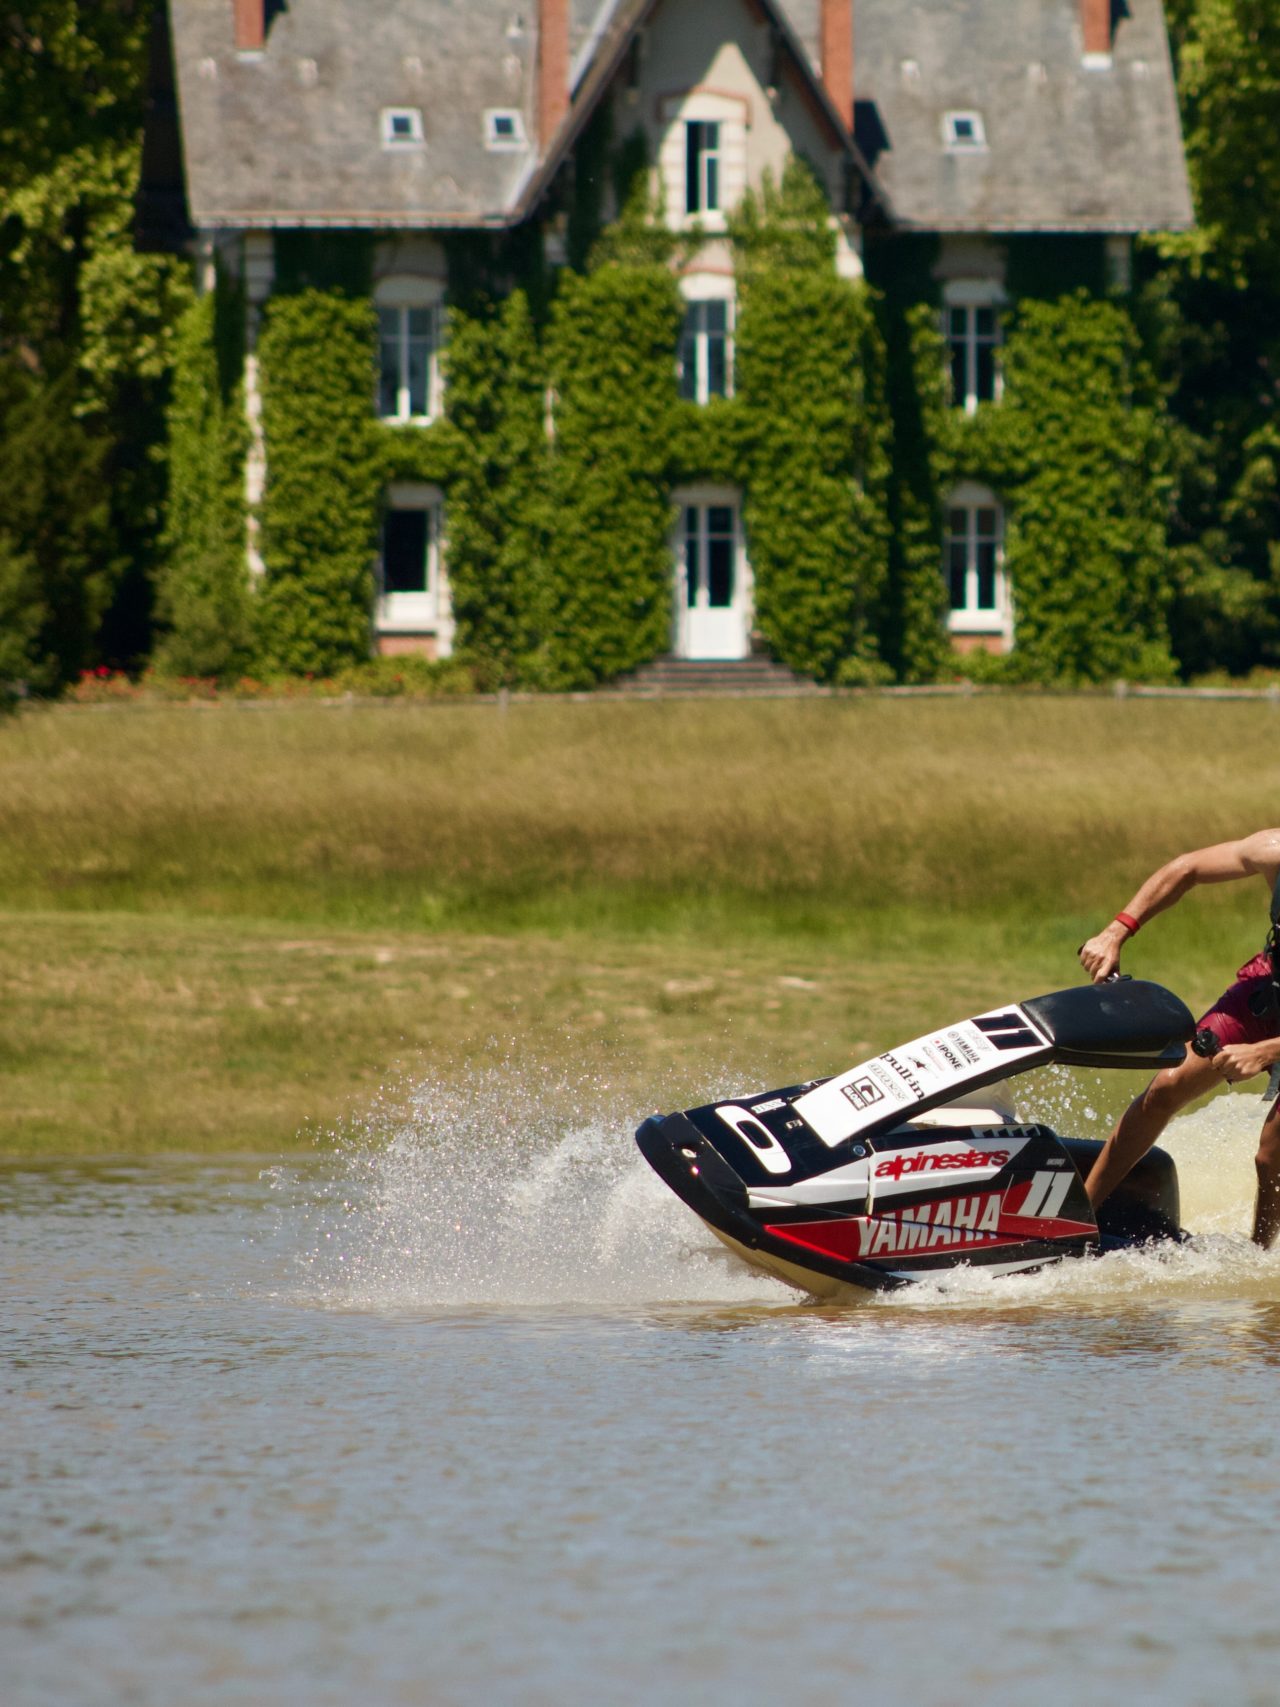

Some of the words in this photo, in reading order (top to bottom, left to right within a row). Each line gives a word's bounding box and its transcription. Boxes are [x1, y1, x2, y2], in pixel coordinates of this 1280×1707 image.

[938, 1043, 963, 1070] IPONE
[955, 1036, 981, 1063] YAMAHA
[879, 1052, 925, 1101] pull-in
[875, 1149, 1011, 1181] alpinestars
[1016, 1171, 1076, 1217] 11
[856, 1194, 1002, 1256] YAMAHA
